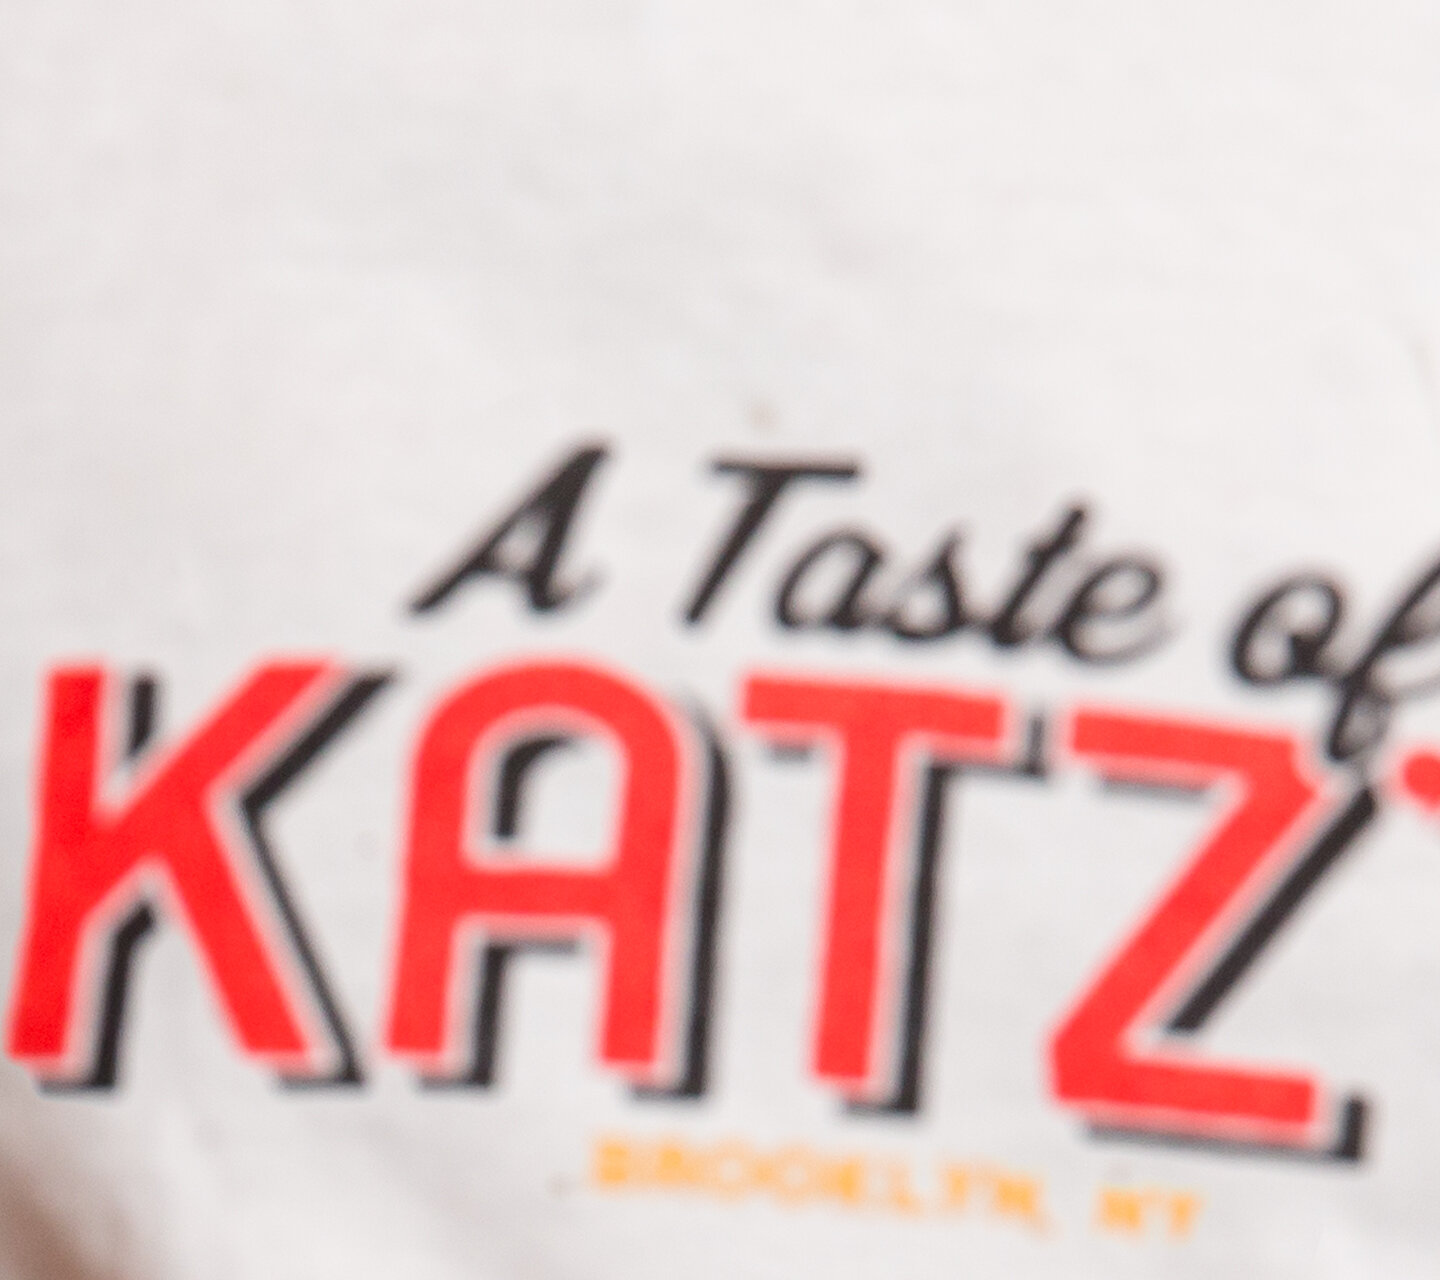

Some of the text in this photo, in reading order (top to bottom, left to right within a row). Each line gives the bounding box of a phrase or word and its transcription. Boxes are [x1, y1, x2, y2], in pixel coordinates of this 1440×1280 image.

[408, 442, 612, 618] A
[682, 454, 1176, 664] Taste
[1092, 1186, 1204, 1240] NY
